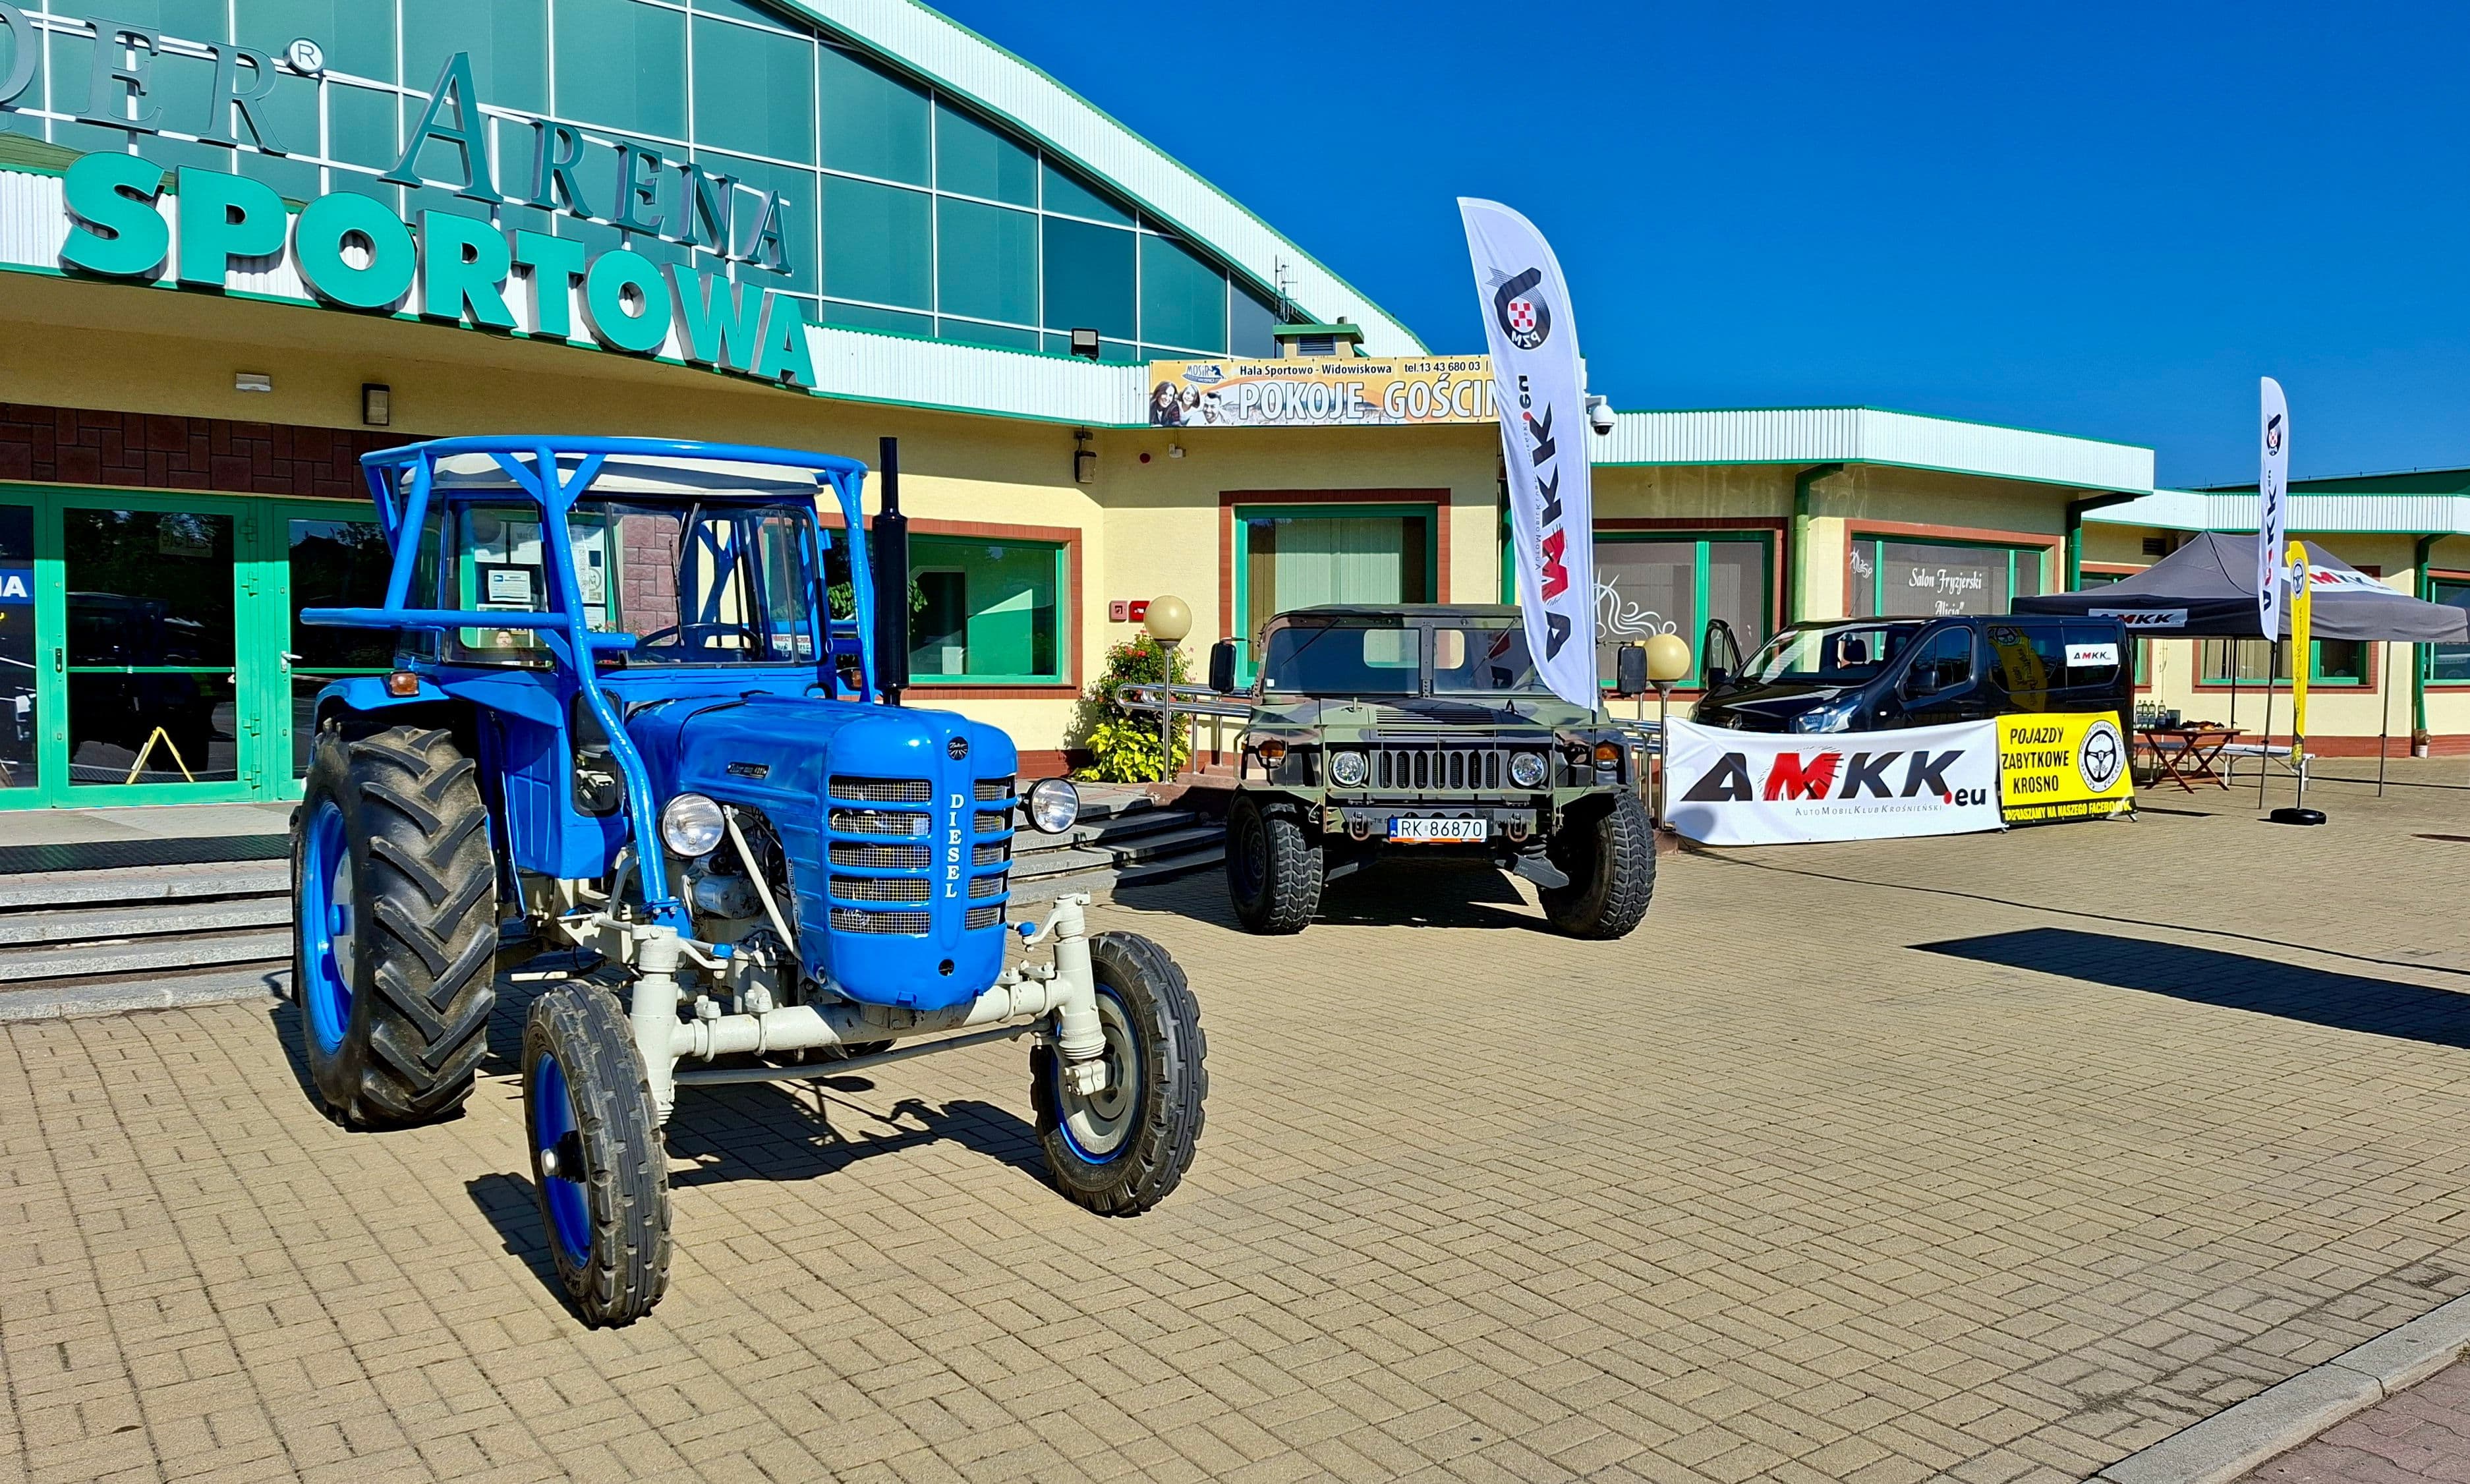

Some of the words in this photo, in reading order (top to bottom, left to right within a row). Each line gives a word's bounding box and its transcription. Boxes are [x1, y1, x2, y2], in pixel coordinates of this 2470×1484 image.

[377, 52, 793, 275] ARENA
[58, 152, 816, 387] SPORTOWA
[1240, 365, 1262, 375] Hala
[1265, 365, 1313, 377] Sportowo
[1321, 364, 1392, 374] Widowiskowa
[1433, 362, 1445, 372] 43
[1448, 362, 1466, 371] 680
[1468, 362, 1480, 370] 03
[1239, 382, 1364, 420] POKOJE
[0, 575, 28, 598] A
[1909, 567, 1934, 587] Salon
[1937, 569, 1982, 595] Fryzjerski
[2100, 614, 2173, 624] MKK
[2010, 727, 2064, 745] POJAZDY
[2001, 751, 2069, 770] ZABYTKOWE
[2013, 775, 2059, 793] KROSNO
[2048, 806, 2057, 818] NA
[2058, 803, 2086, 816] NASZEGO
[2089, 800, 2132, 814] FACEBOOK
[1402, 821, 1422, 836] RK
[1430, 821, 1482, 837] 86870
[945, 794, 964, 898] DIESEL
